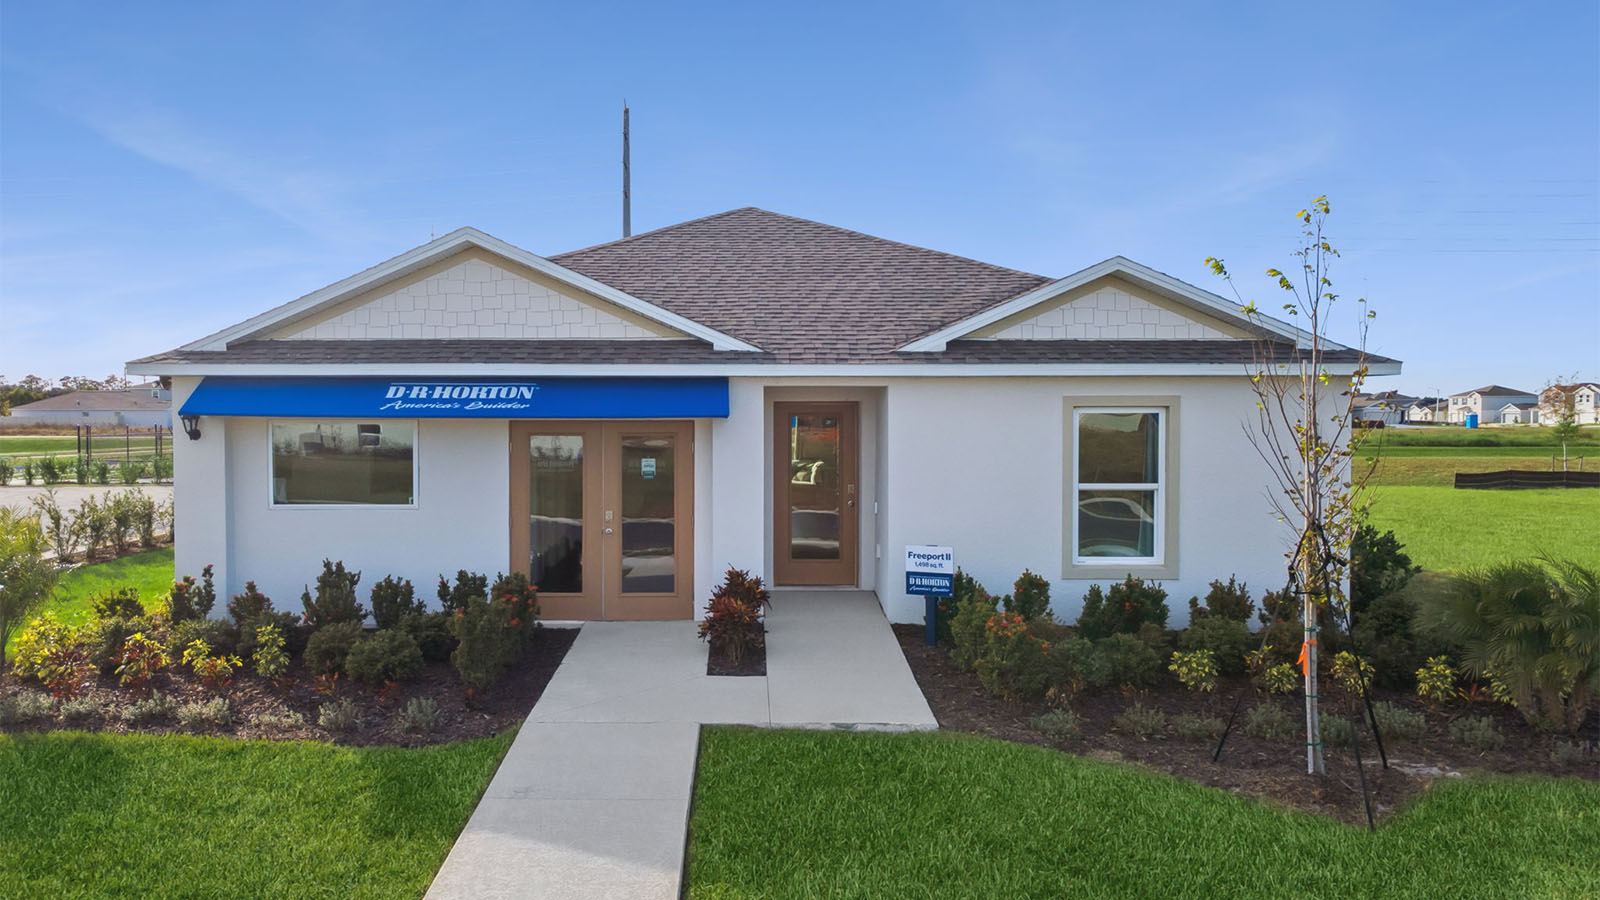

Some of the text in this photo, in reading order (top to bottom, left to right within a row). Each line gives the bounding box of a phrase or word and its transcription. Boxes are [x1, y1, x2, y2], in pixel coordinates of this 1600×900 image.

[380, 400, 531, 410] America's Builder
[908, 551, 945, 561] Freeport
